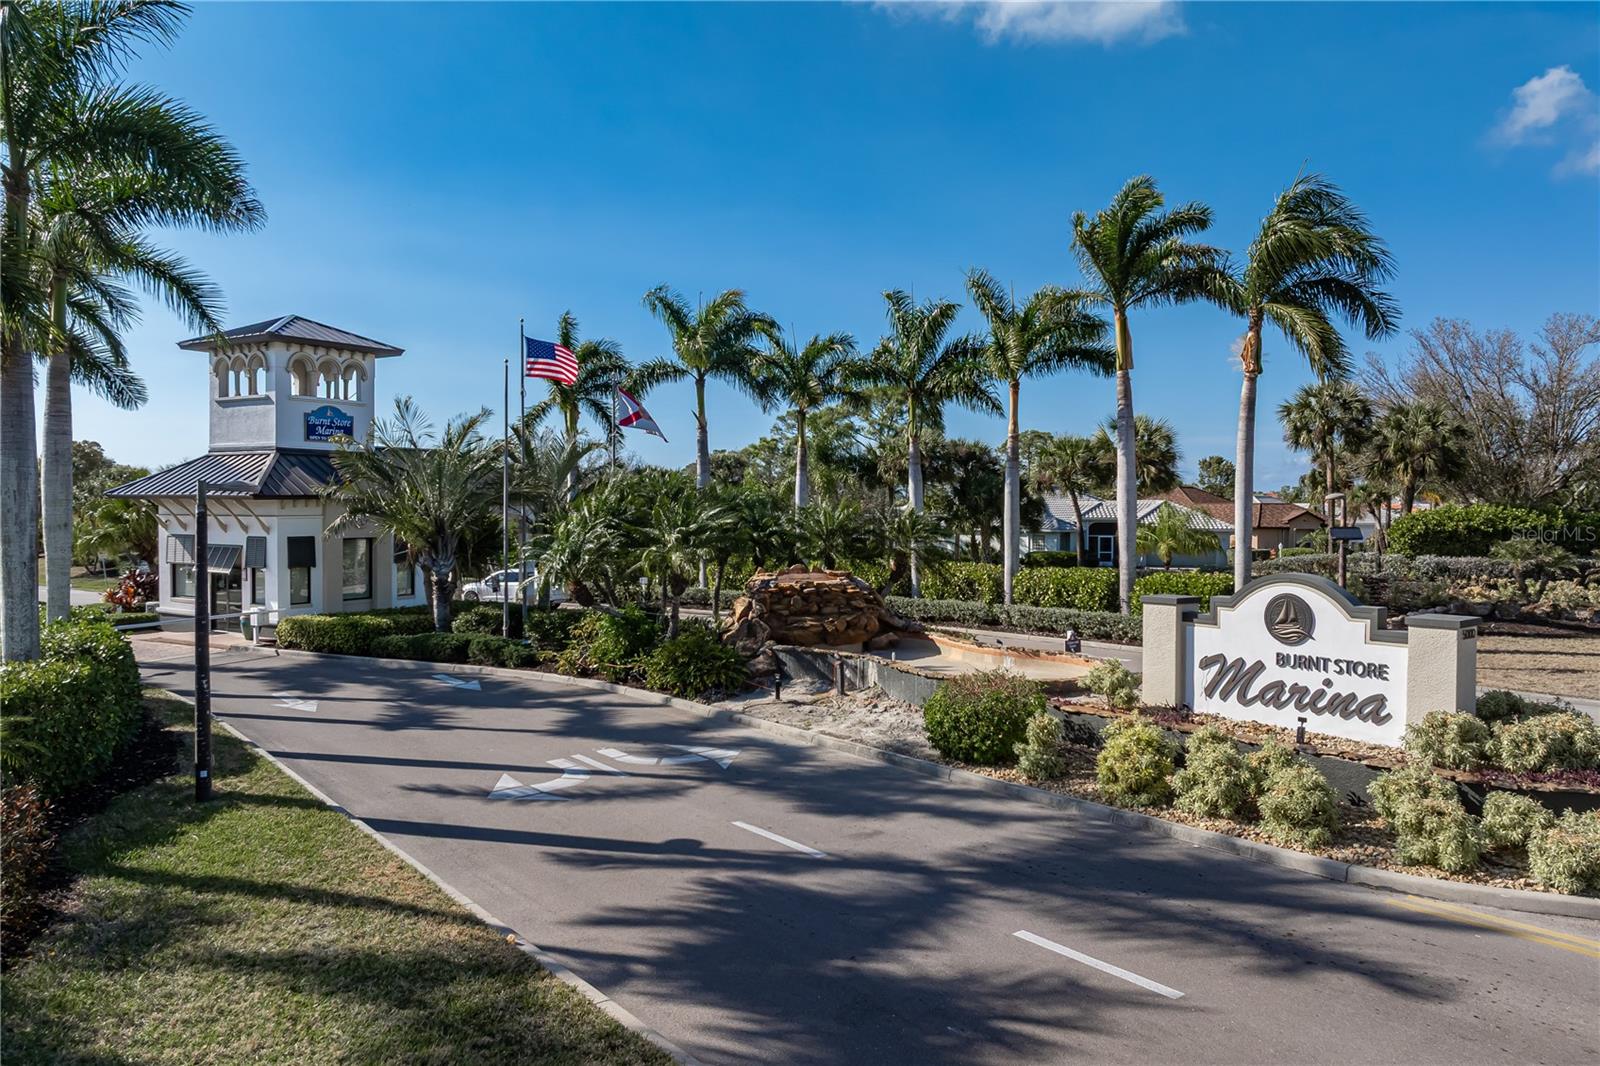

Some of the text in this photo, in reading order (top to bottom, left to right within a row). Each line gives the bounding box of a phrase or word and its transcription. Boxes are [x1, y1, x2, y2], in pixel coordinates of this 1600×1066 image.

[308, 416, 351, 427] Burnt Store
[315, 426, 344, 435] Marina
[1276, 652, 1390, 682] BURNT STORE
[1199, 653, 1393, 726] Marina
